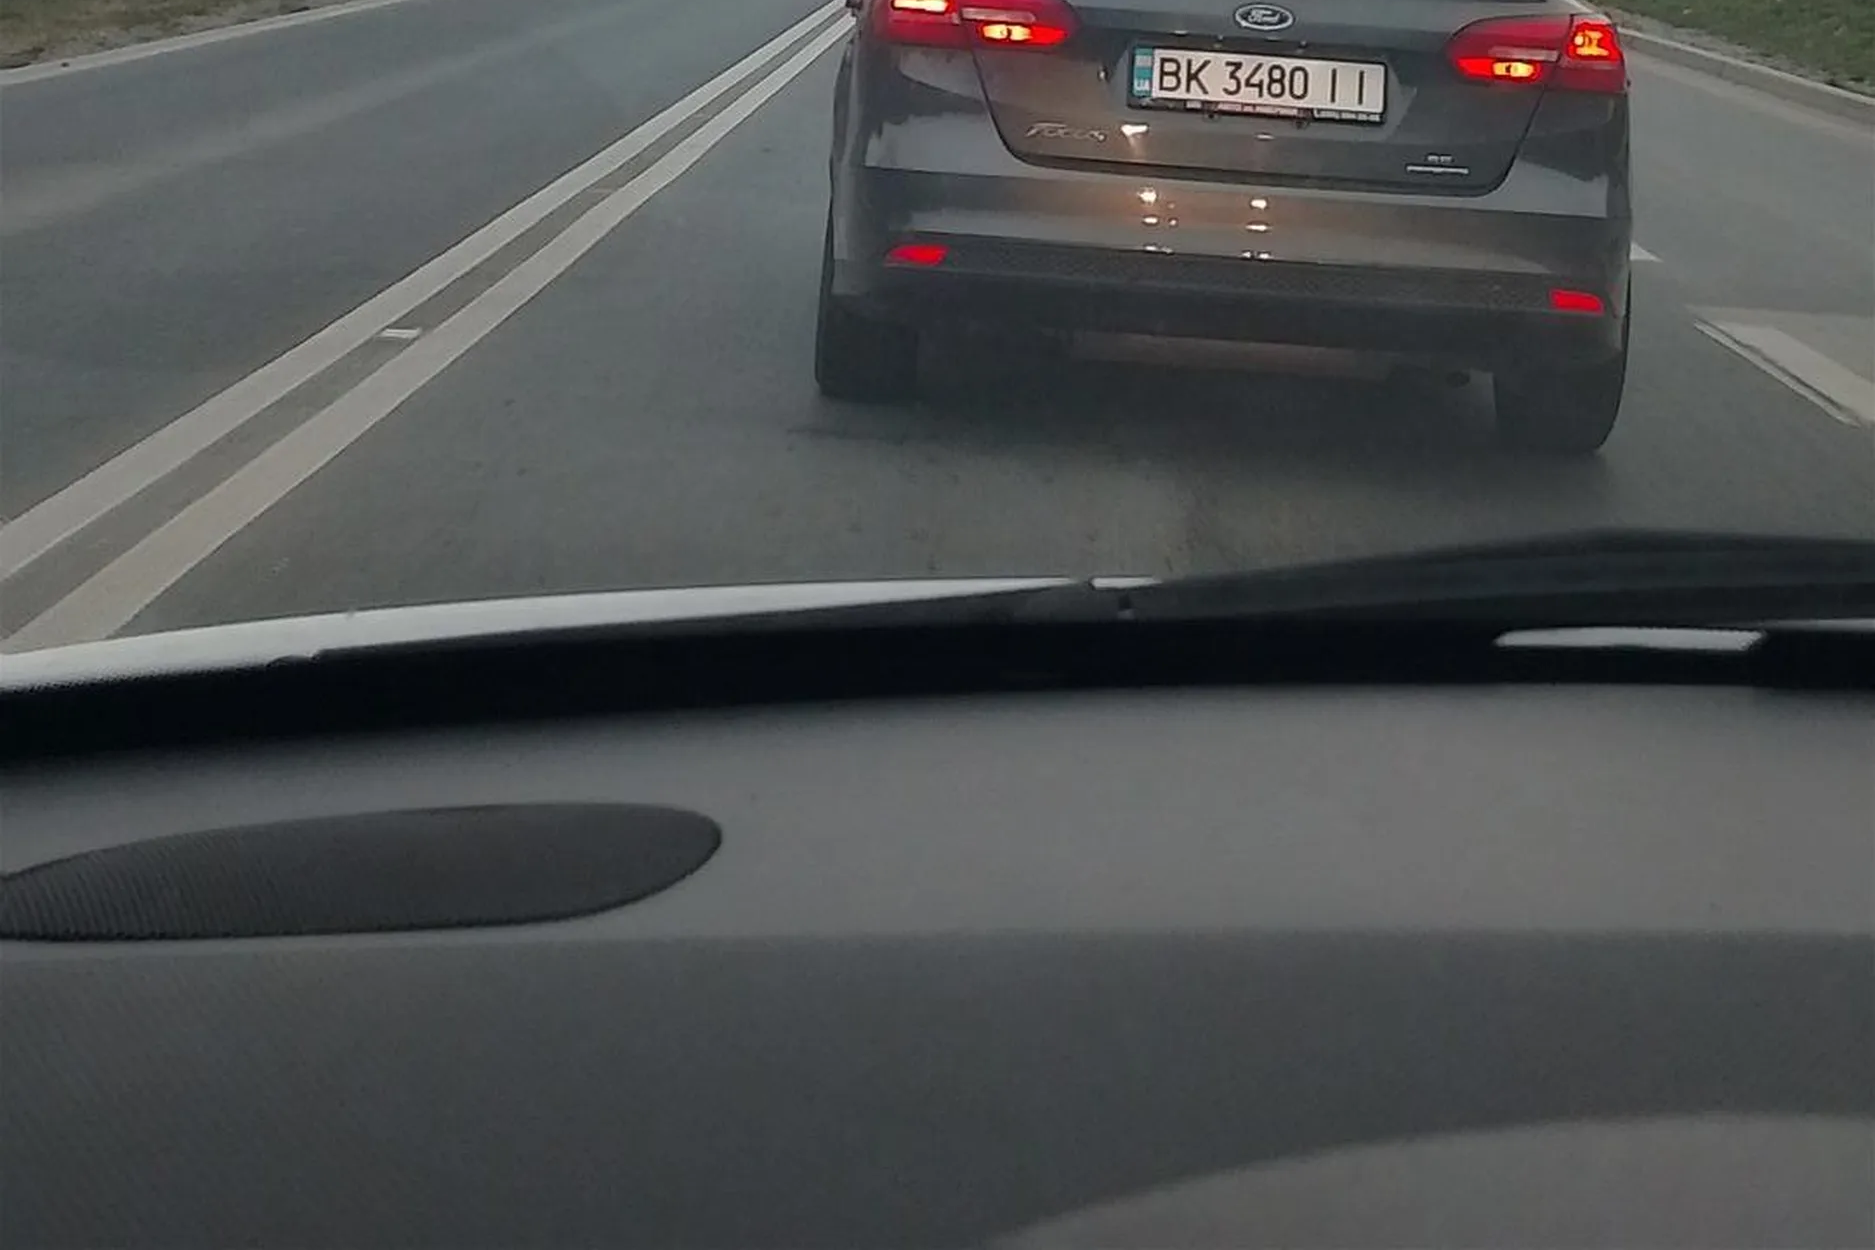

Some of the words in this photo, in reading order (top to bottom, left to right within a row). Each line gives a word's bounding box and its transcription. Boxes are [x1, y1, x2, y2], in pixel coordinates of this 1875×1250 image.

[1247, 8, 1281, 24] Ford
[1158, 57, 1212, 95] BK
[1222, 61, 1309, 100] 3480
